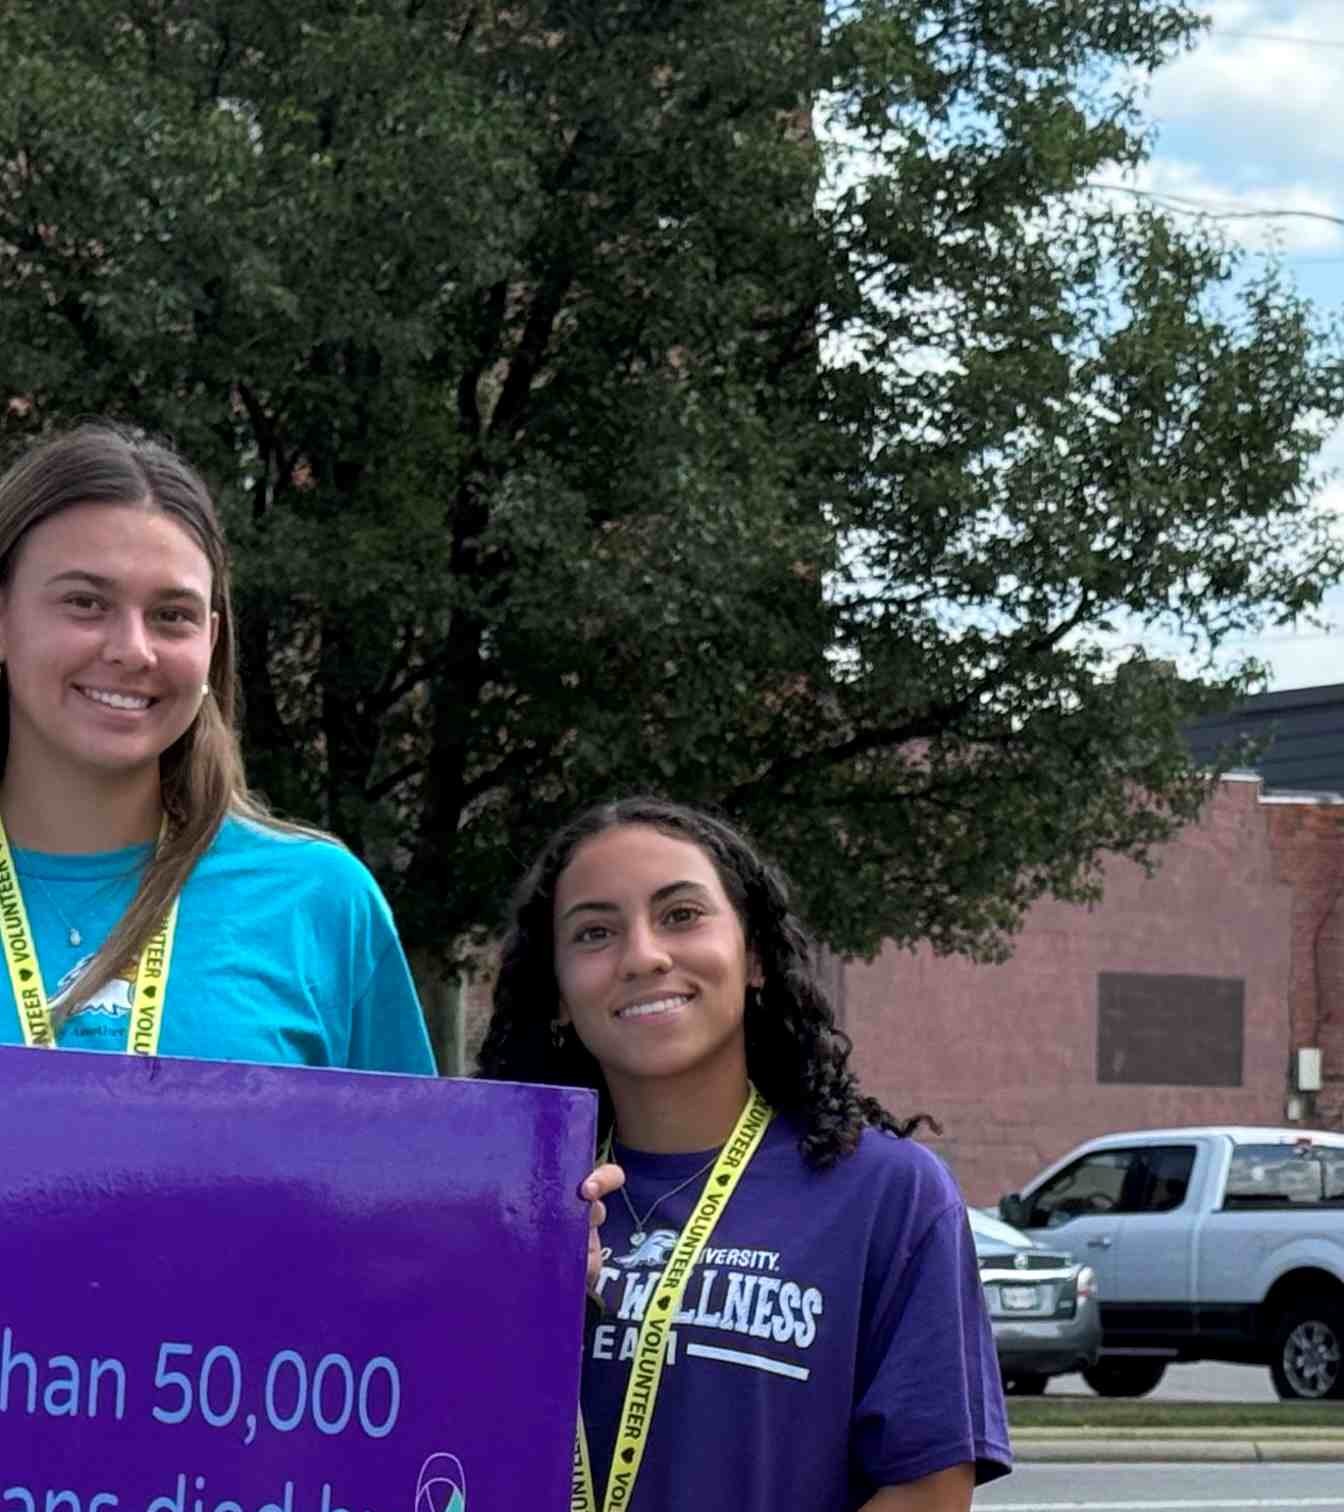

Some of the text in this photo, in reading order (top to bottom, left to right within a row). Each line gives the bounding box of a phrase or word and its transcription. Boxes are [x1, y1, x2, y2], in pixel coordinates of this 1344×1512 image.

[22, 987, 49, 1046] NTEER
[661, 1192, 725, 1290] VOLUNTEER
[699, 1247, 781, 1273] IVERSITY.
[152, 1342, 401, 1444] 50,000
[623, 1318, 667, 1441] VOLUNTEER
